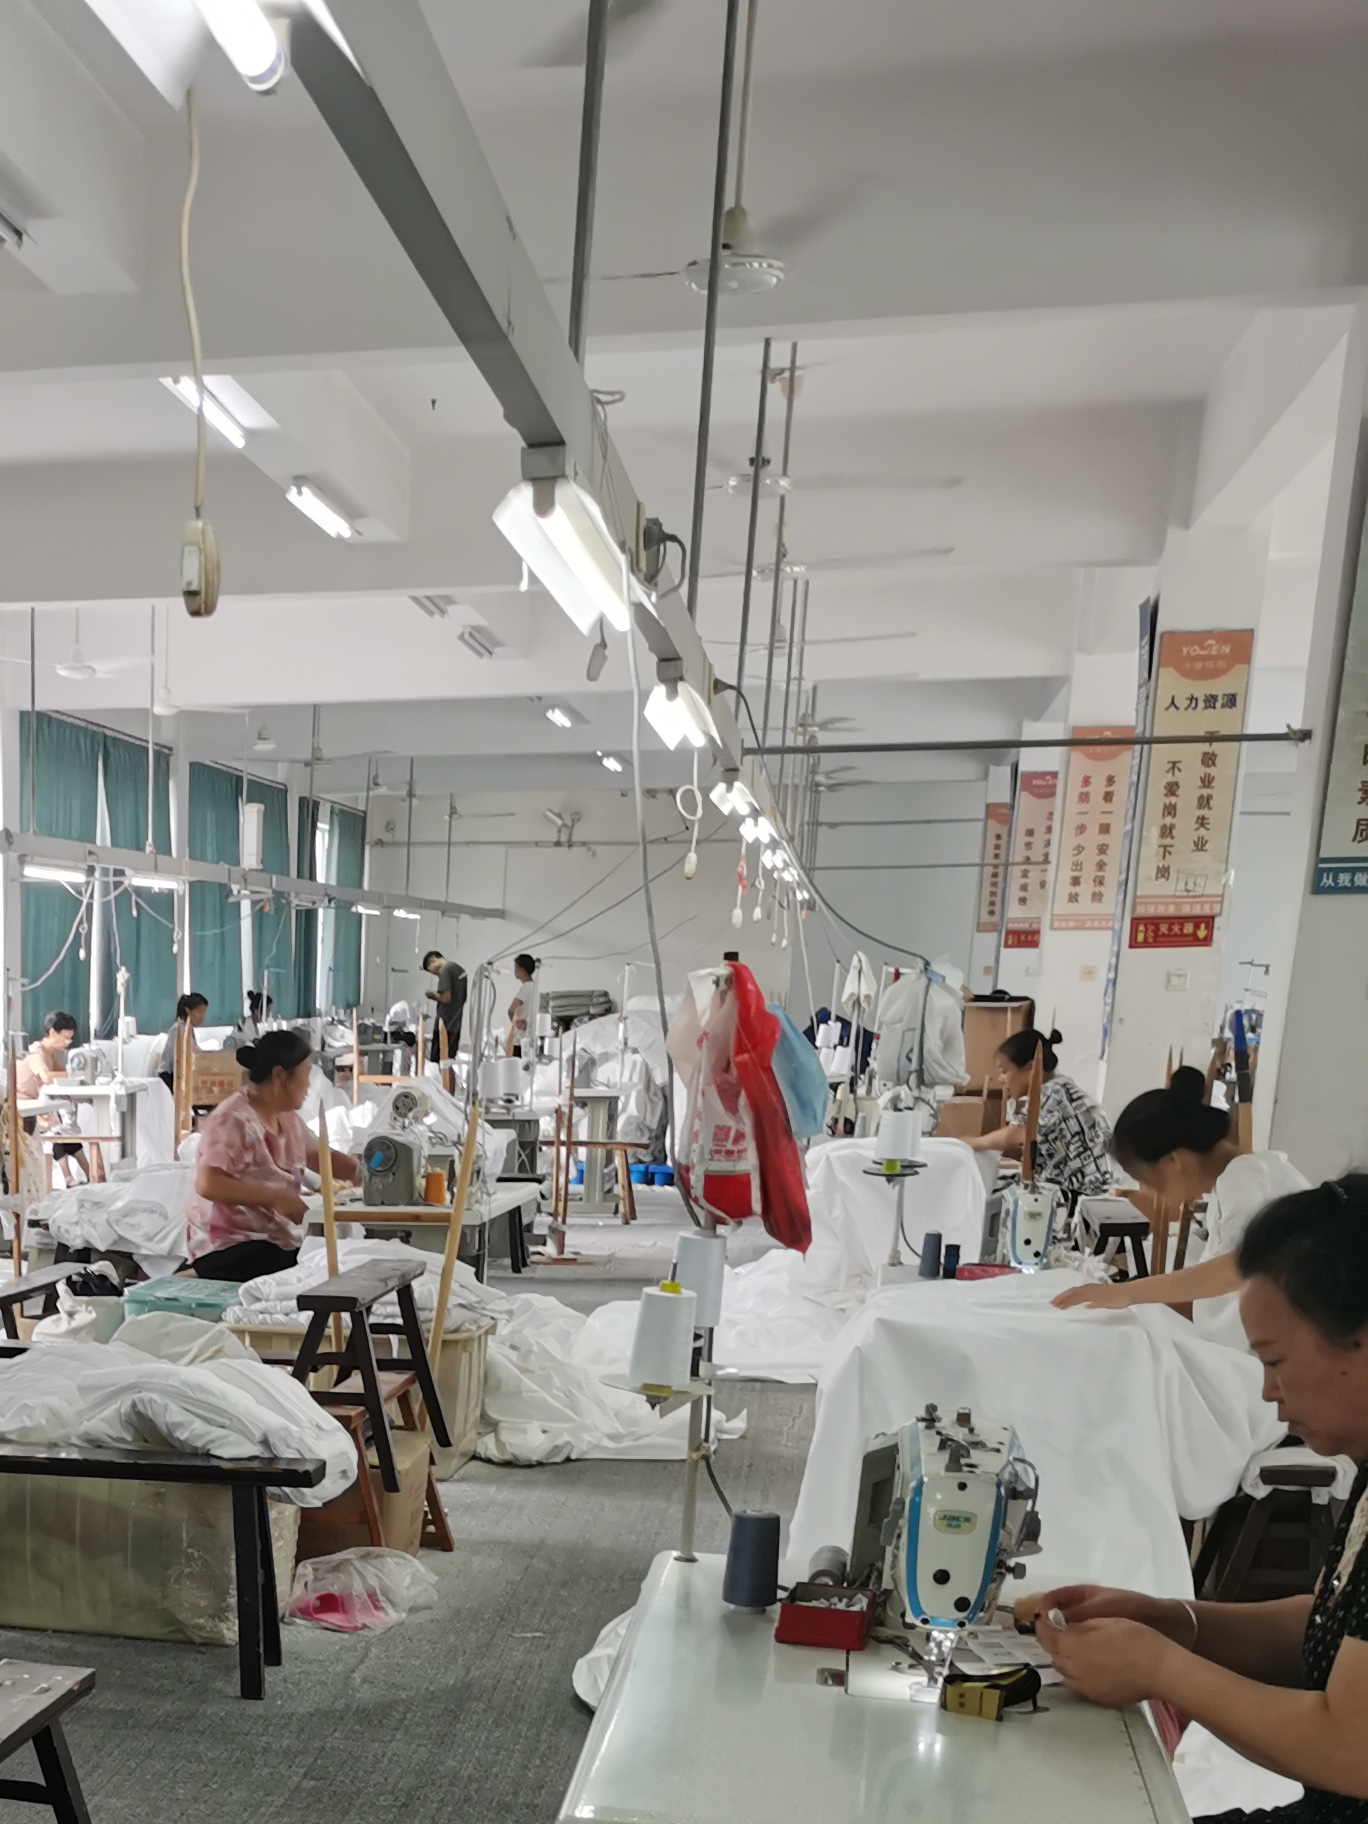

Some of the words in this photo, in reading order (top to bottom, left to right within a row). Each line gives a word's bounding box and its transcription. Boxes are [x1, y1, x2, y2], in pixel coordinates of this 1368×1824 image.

[1164, 692, 1238, 712] 人力资源
[1154, 760, 1183, 882] 不爱岗就下岗
